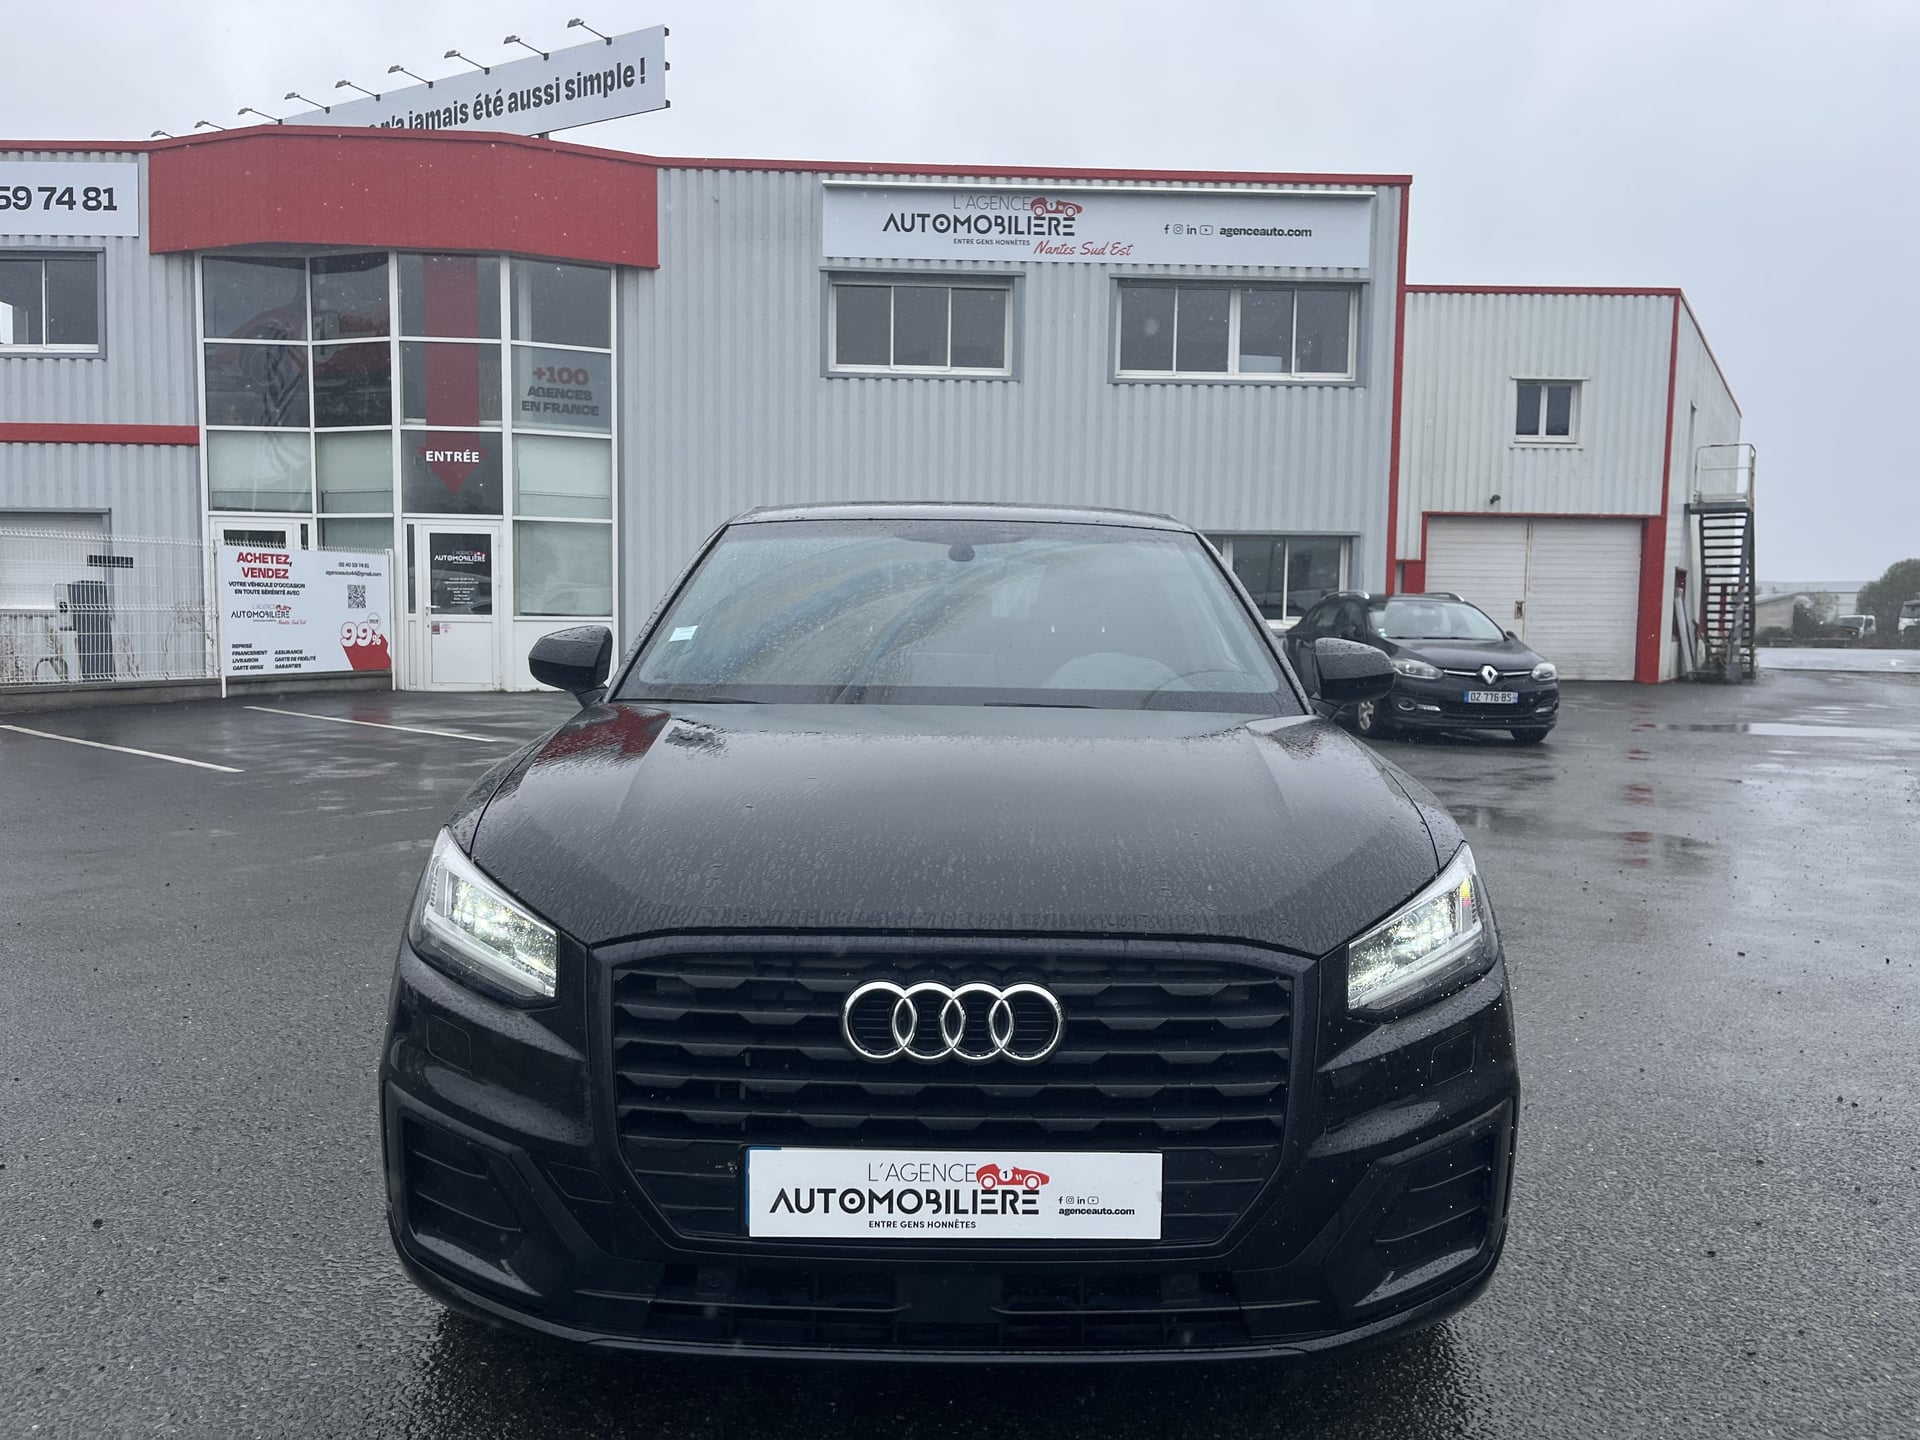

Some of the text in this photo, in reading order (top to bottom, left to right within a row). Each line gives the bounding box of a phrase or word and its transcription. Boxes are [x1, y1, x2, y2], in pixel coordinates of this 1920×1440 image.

[408, 100, 469, 130] jamais
[472, 88, 503, 121] été
[507, 77, 560, 113] aussi
[564, 62, 636, 101] simple
[0, 186, 118, 211] 59 74 81
[953, 195, 1031, 211] L'AGENCE
[1219, 226, 1312, 238] agenceauto.com
[1033, 240, 1135, 257] Nantes Sud Est
[532, 366, 590, 386] +100
[527, 385, 594, 401] AGENCES
[521, 400, 600, 417] EN FRANCE
[425, 448, 480, 463] ENTRÉE
[236, 552, 293, 567] ACHETEZ,
[241, 566, 290, 580] VENDEZ
[243, 588, 261, 596] TOUTE
[273, 582, 306, 590] D'OCCASION
[868, 1162, 977, 1183] L'AGENCE
[1058, 1207, 1135, 1216] agenceauto.com
[868, 1218, 977, 1229] ENTRE GENS HONNÊTES
